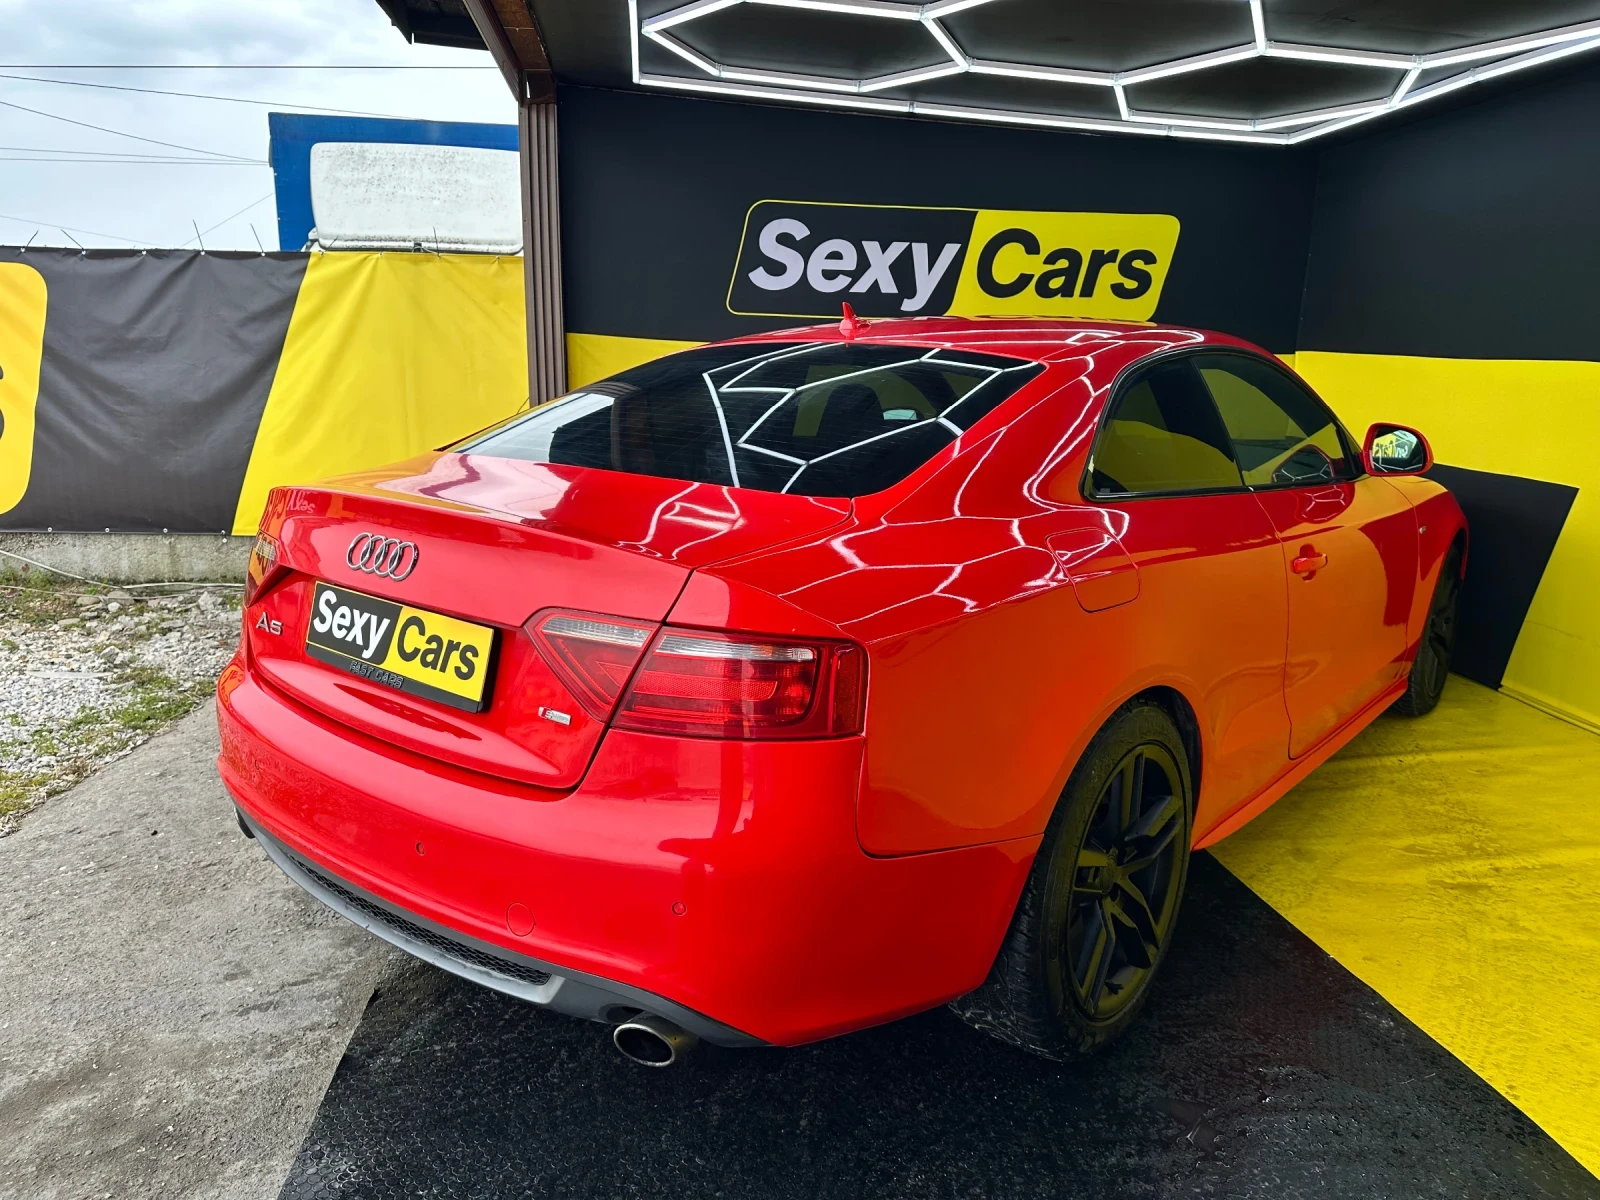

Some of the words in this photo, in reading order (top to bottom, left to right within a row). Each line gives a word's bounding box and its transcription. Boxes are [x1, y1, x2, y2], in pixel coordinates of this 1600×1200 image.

[748, 218, 962, 312] Sexy
[976, 228, 1157, 300] Cars
[256, 611, 283, 636] A5
[313, 590, 391, 660] Sexy
[396, 615, 479, 681] Cars
[350, 660, 375, 678] FAST
[375, 670, 404, 689] CARS
